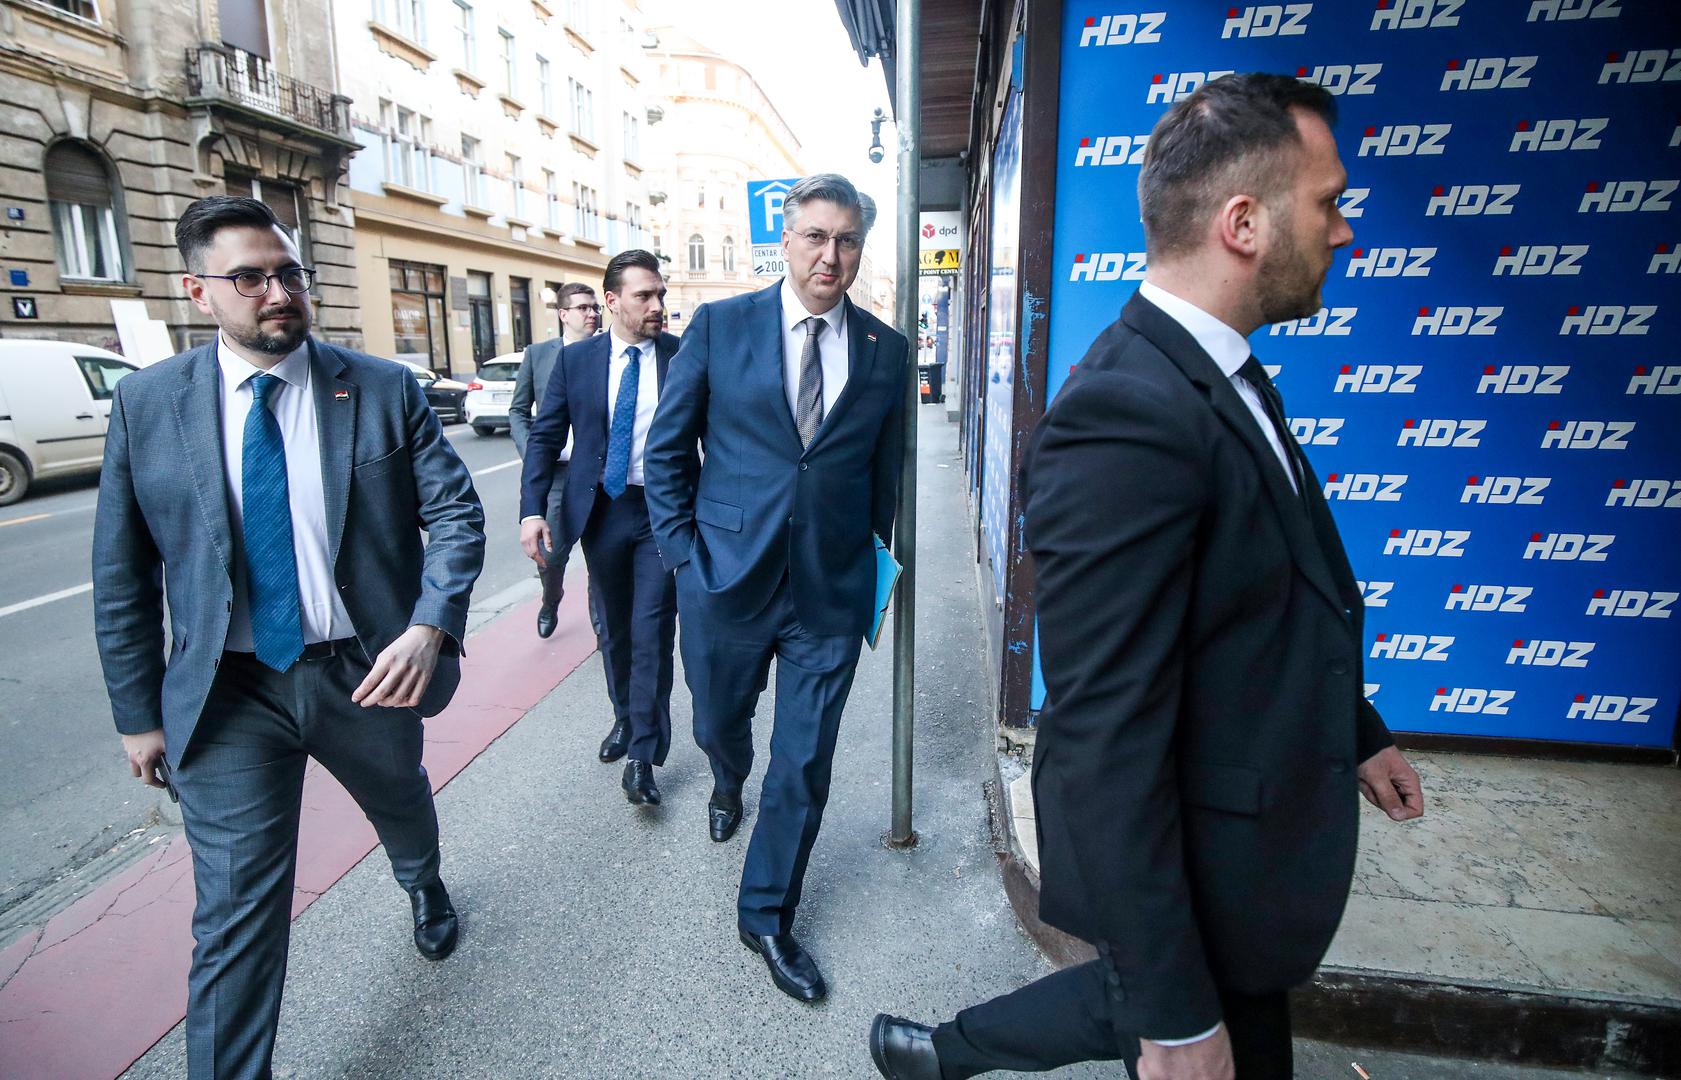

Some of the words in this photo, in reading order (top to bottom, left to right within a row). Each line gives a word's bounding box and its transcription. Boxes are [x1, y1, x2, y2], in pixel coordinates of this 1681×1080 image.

[1080, 12, 1167, 47] HDZ
[1222, 4, 1312, 38] HDZ
[1370, 0, 1466, 31] HDZ
[1440, 55, 1539, 91] HDZ
[1357, 123, 1453, 156] HDZ
[1508, 117, 1610, 152] HDZ
[1074, 135, 1151, 167] HDZ
[1425, 184, 1521, 216] HDZ
[1578, 179, 1681, 212] HDZ
[764, 191, 786, 232] P
[938, 225, 958, 237] dpd
[754, 249, 778, 257] CENTAR
[765, 260, 784, 273] 200
[1069, 252, 1147, 282] HDZ
[1345, 247, 1438, 278] HDZ
[1492, 244, 1590, 276] HDZ
[1411, 306, 1505, 336] HDZ
[1559, 305, 1658, 336] HDZ
[1333, 365, 1424, 393] HDZ
[1476, 365, 1571, 394] HDZ
[1626, 365, 1681, 395] HD
[1285, 417, 1345, 446] DZ
[1397, 419, 1488, 448] HDZ
[1540, 420, 1637, 450] HDZ
[1323, 473, 1409, 502] HDZ
[1460, 476, 1552, 505] HDZ
[1383, 529, 1471, 557] HDZ
[1523, 533, 1616, 562] HDZ
[1444, 584, 1534, 613] HDZ
[1585, 589, 1680, 619] HDZ
[1369, 633, 1456, 662] HDZ
[1505, 639, 1596, 668] HDZ
[1429, 687, 1516, 715] HDZ
[1566, 694, 1659, 723] HDZ
